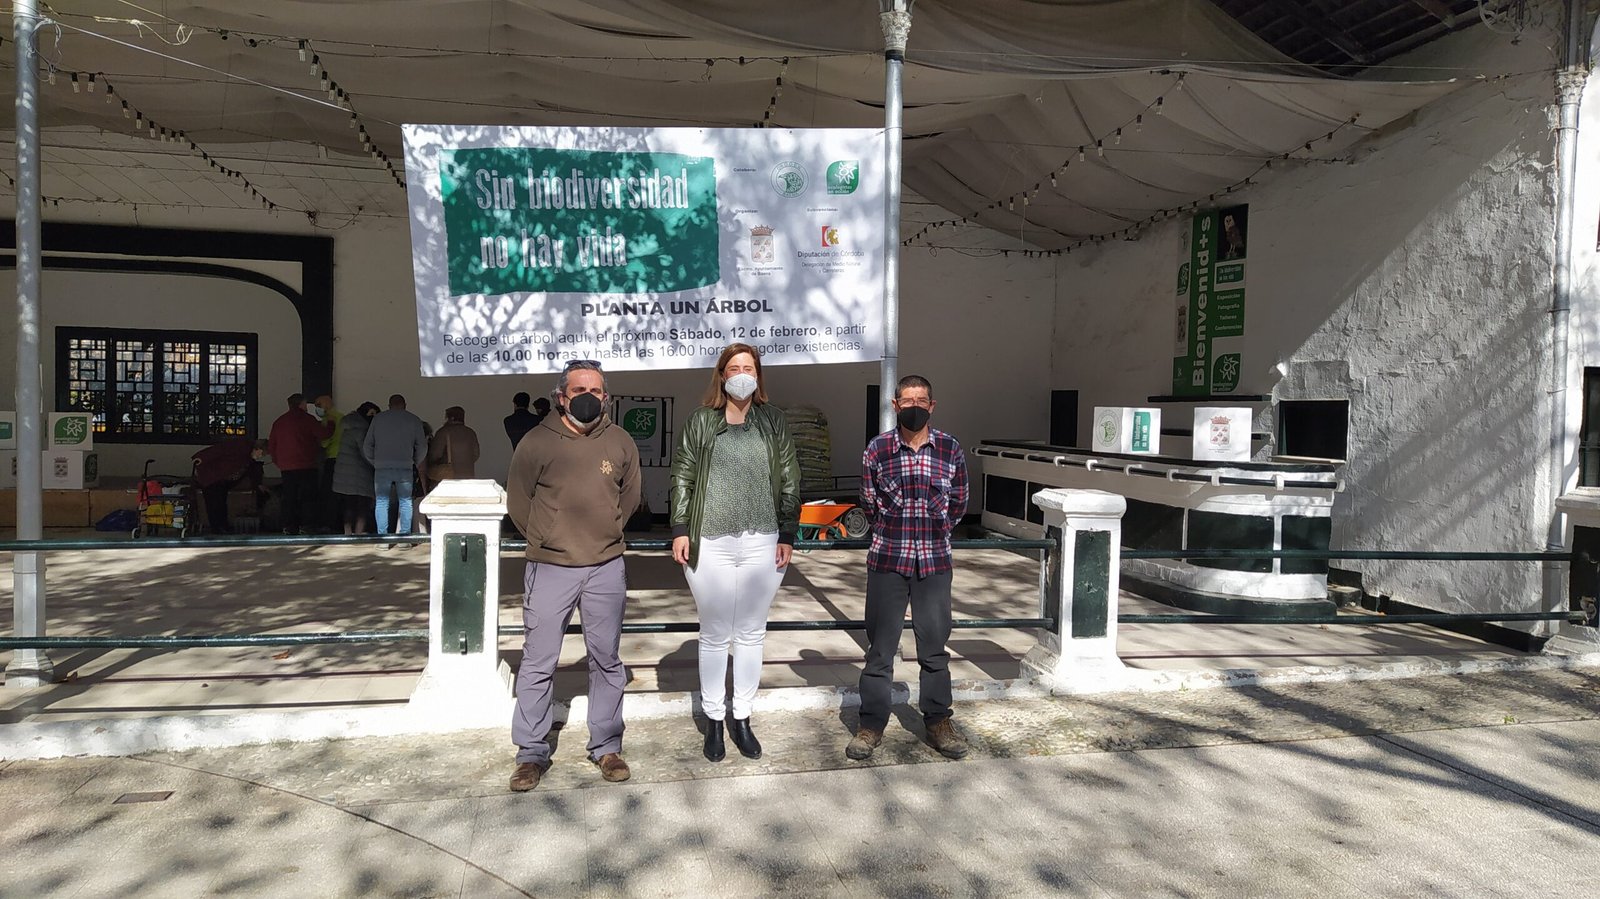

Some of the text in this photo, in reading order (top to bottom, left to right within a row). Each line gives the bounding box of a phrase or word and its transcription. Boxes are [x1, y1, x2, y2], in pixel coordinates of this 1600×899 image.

[475, 168, 689, 210] Sin biodiversidad
[480, 226, 628, 274] no hay vida
[797, 250, 830, 258] Diputación
[581, 297, 773, 317] PLANTA UN ÁRBOL
[1191, 215, 1211, 387] Bienvenid+s
[443, 324, 867, 349] Recoge tu árbol aquí, el próximo Sábado, 12 de febrero, a partir
[446, 352, 464, 363] de
[468, 351, 489, 363] las
[494, 350, 532, 362] 10.00
[537, 349, 578, 361] horas
[584, 350, 591, 360] y
[594, 347, 631, 360] hasta
[635, 346, 655, 359] las
[659, 344, 695, 357] 16.00
[794, 339, 864, 353] existencias.
